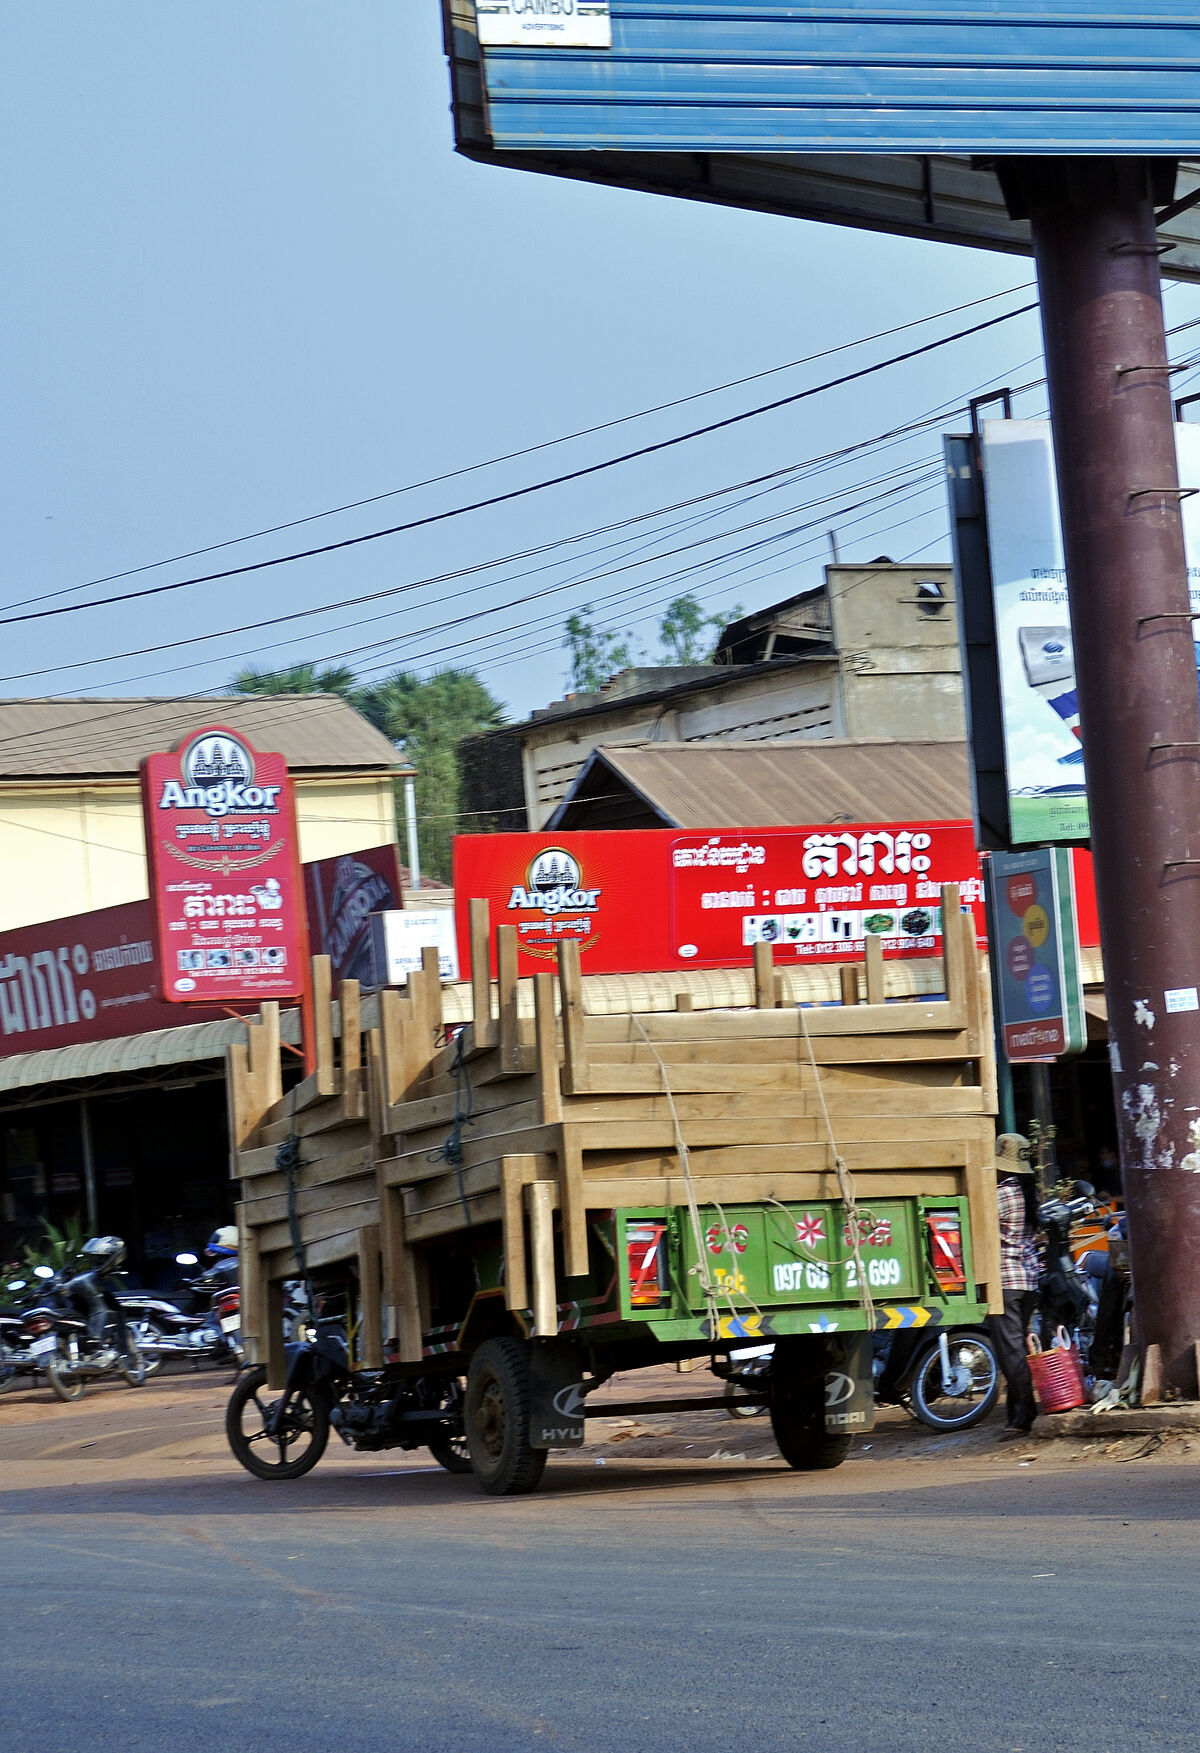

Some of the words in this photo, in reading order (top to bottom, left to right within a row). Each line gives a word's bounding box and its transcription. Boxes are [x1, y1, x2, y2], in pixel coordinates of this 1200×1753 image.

[159, 778, 281, 817] Angkor
[507, 885, 602, 915] Angkor
[773, 1262, 804, 1292] 097
[868, 1258, 900, 1287] 699
